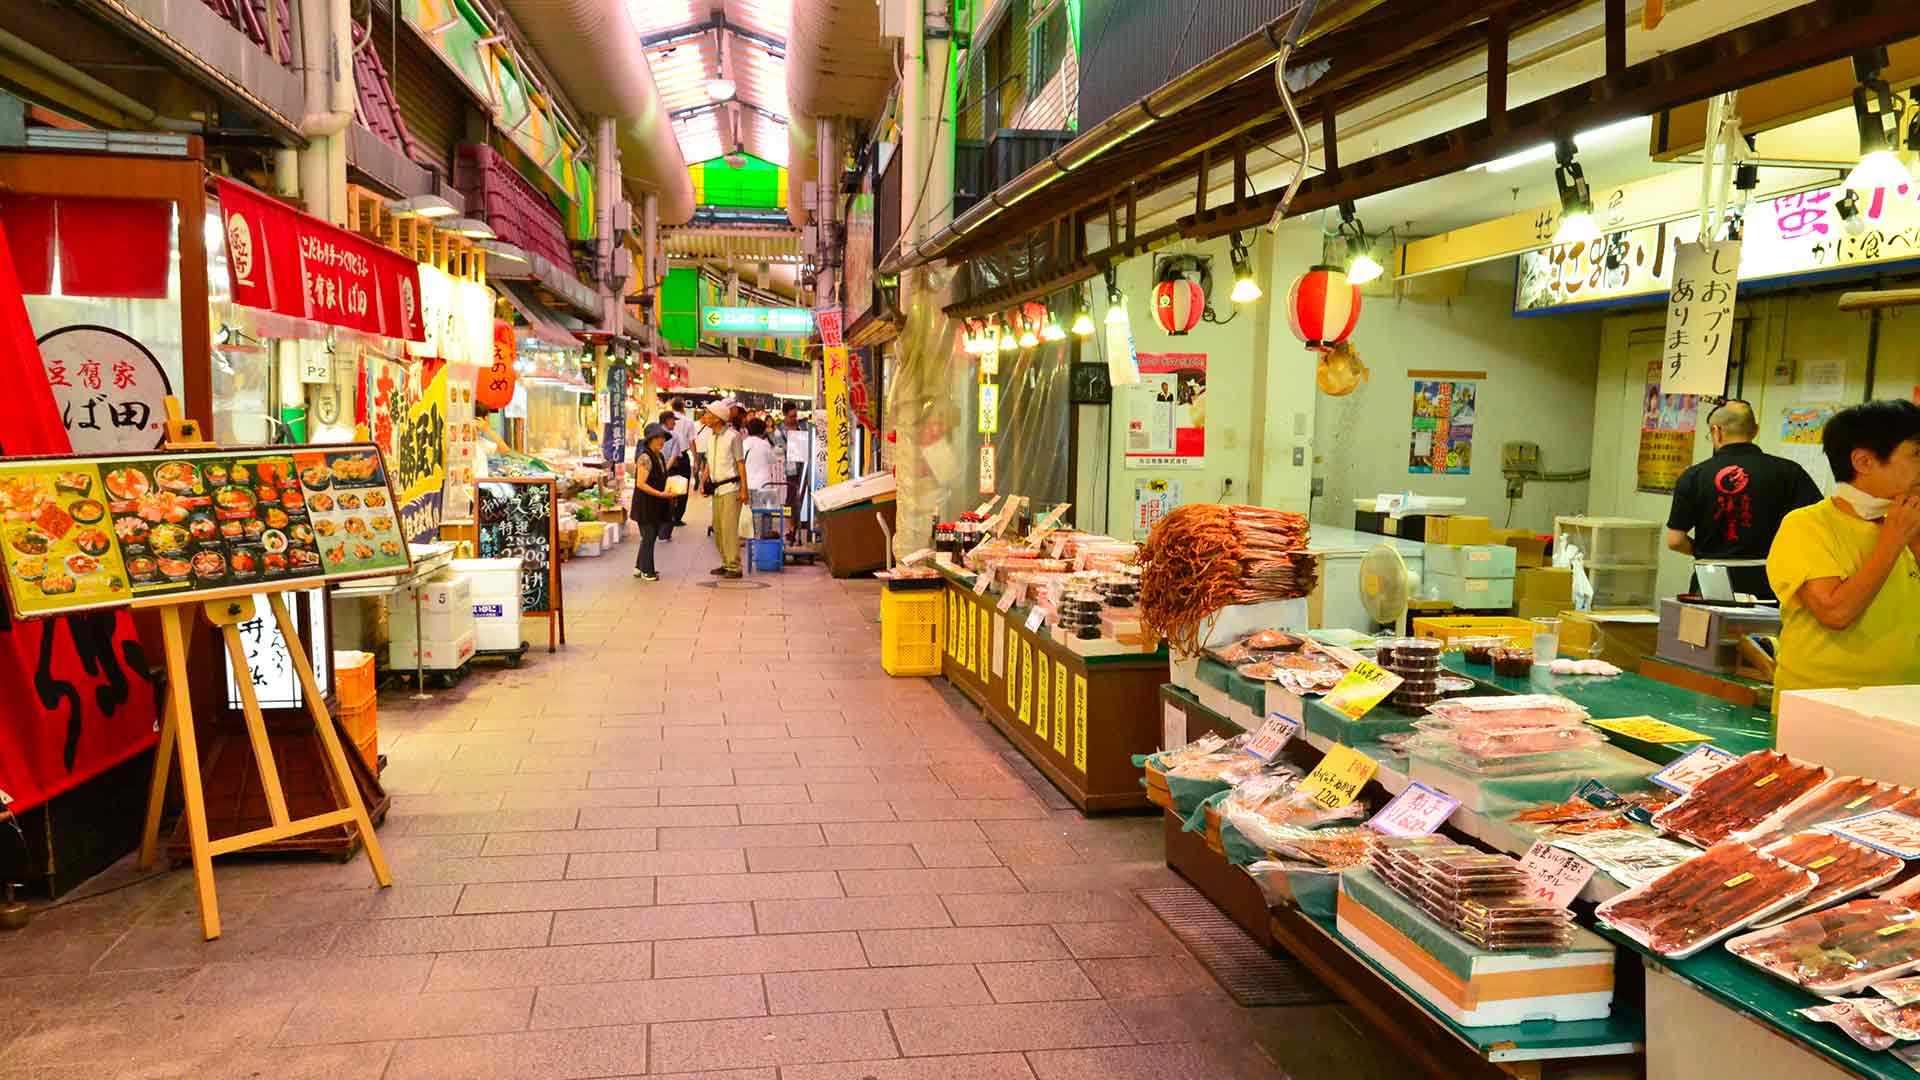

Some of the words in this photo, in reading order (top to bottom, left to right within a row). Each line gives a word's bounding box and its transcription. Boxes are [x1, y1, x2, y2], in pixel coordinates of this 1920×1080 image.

[1774, 184, 1920, 240] 蟹小
[1812, 228, 1920, 265] かに食べ
[1700, 248, 1732, 357] しおブリ
[1668, 278, 1695, 380] あります
[48, 359, 137, 390] 豆腐家
[307, 366, 326, 377] P2
[63, 393, 150, 431] ば田
[438, 593, 447, 605] 5
